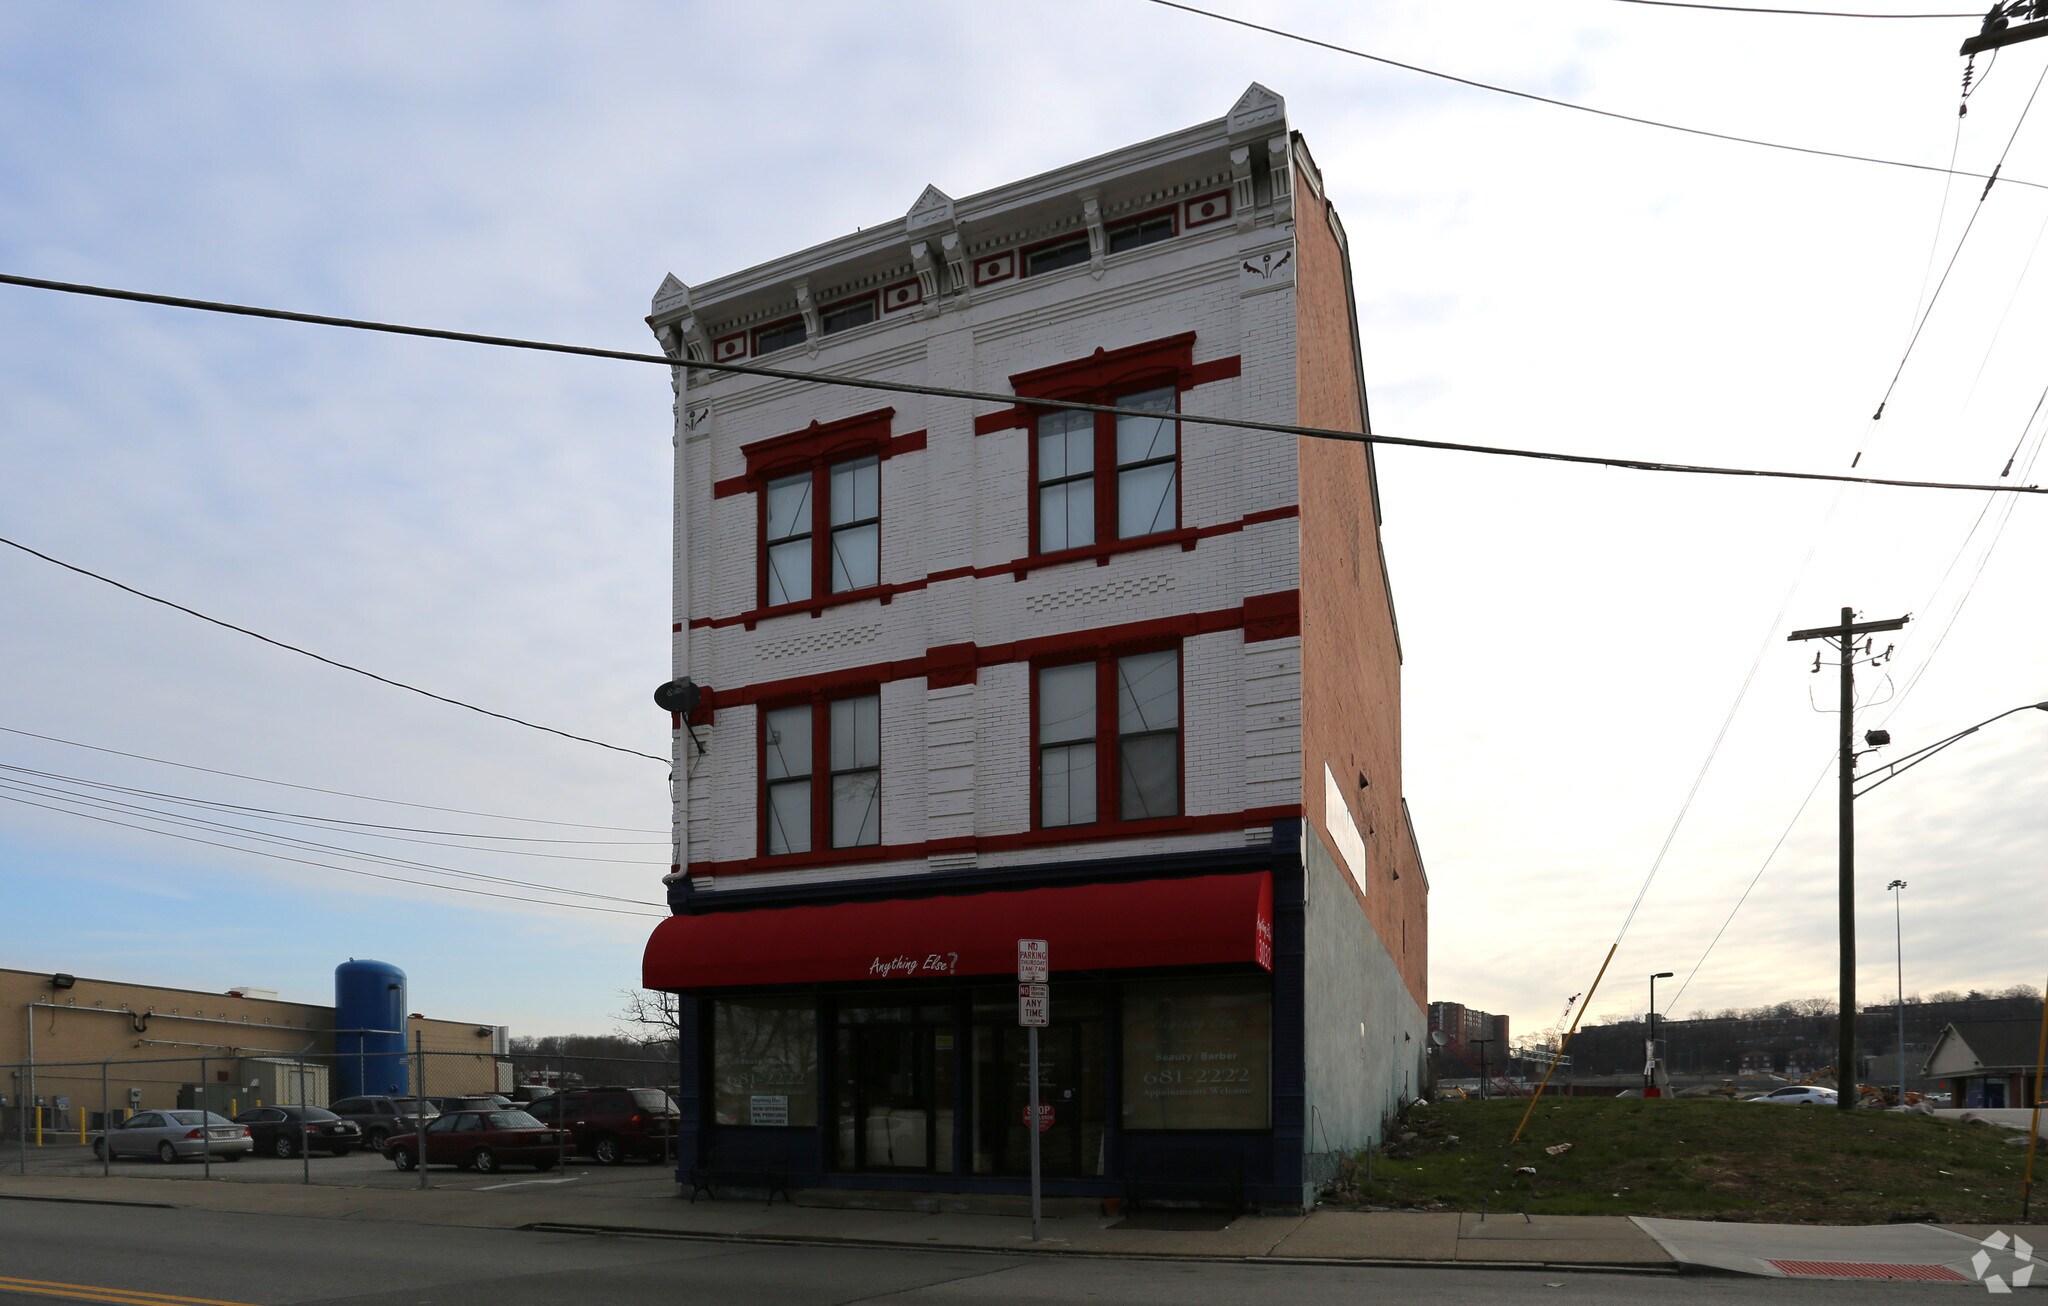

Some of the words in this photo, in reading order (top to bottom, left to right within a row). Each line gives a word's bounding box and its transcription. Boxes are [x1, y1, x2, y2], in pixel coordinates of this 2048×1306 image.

[1028, 943, 1038, 951] NO
[1020, 952, 1046, 960] PARKING
[869, 955, 918, 978] Anything
[1020, 987, 1029, 995] NO
[1026, 999, 1042, 1007] ANY
[1025, 1009, 1043, 1018] TIME
[1155, 1053, 1192, 1063] Beauty
[1200, 1052, 1237, 1061] Barber
[727, 1072, 806, 1085] 681-2222
[1144, 1068, 1250, 1085] 681-2222
[1027, 1105, 1050, 1115] SOP
